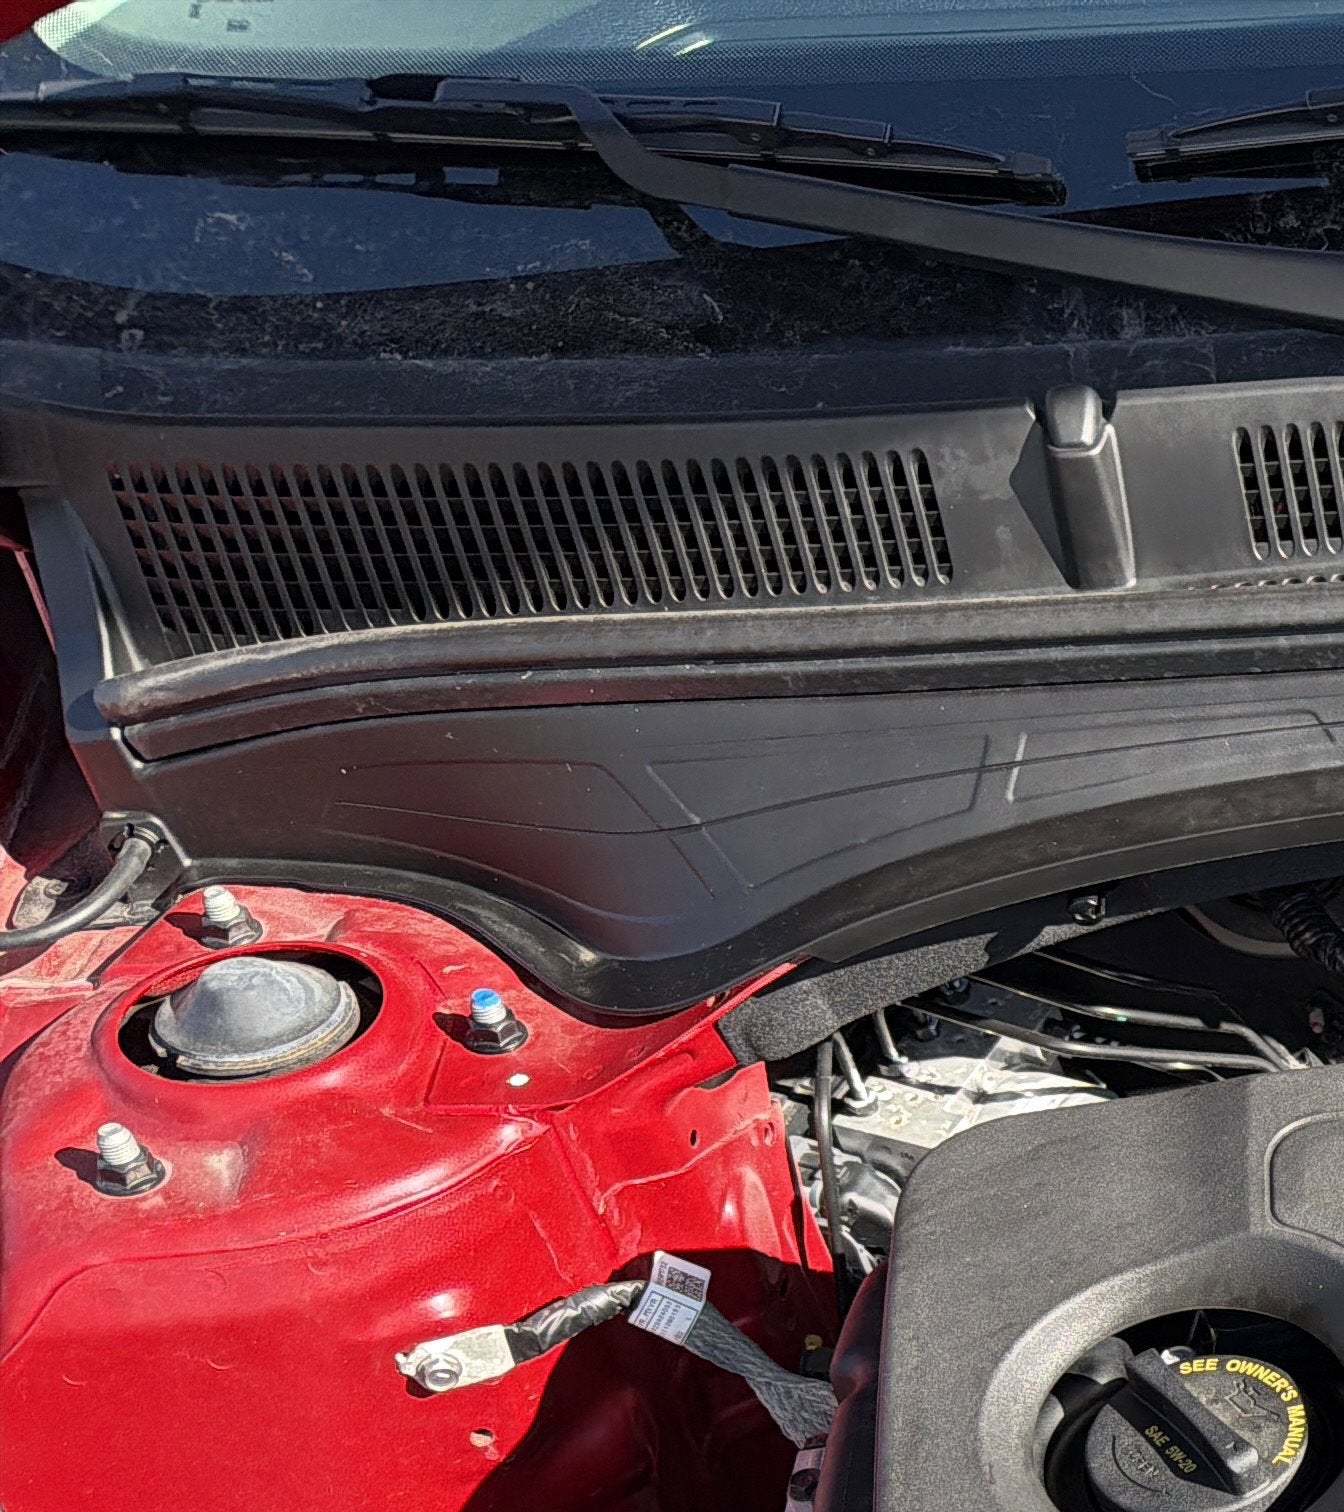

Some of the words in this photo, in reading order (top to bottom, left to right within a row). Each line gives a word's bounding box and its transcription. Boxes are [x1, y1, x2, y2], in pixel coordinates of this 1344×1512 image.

[1144, 1425, 1171, 1448] SAE
[1164, 1441, 1198, 1474] 5W-20
[1179, 1358, 1218, 1375] SEE
[1225, 1359, 1299, 1403] OWNER'S
[1271, 1405, 1308, 1466] MANUAL
